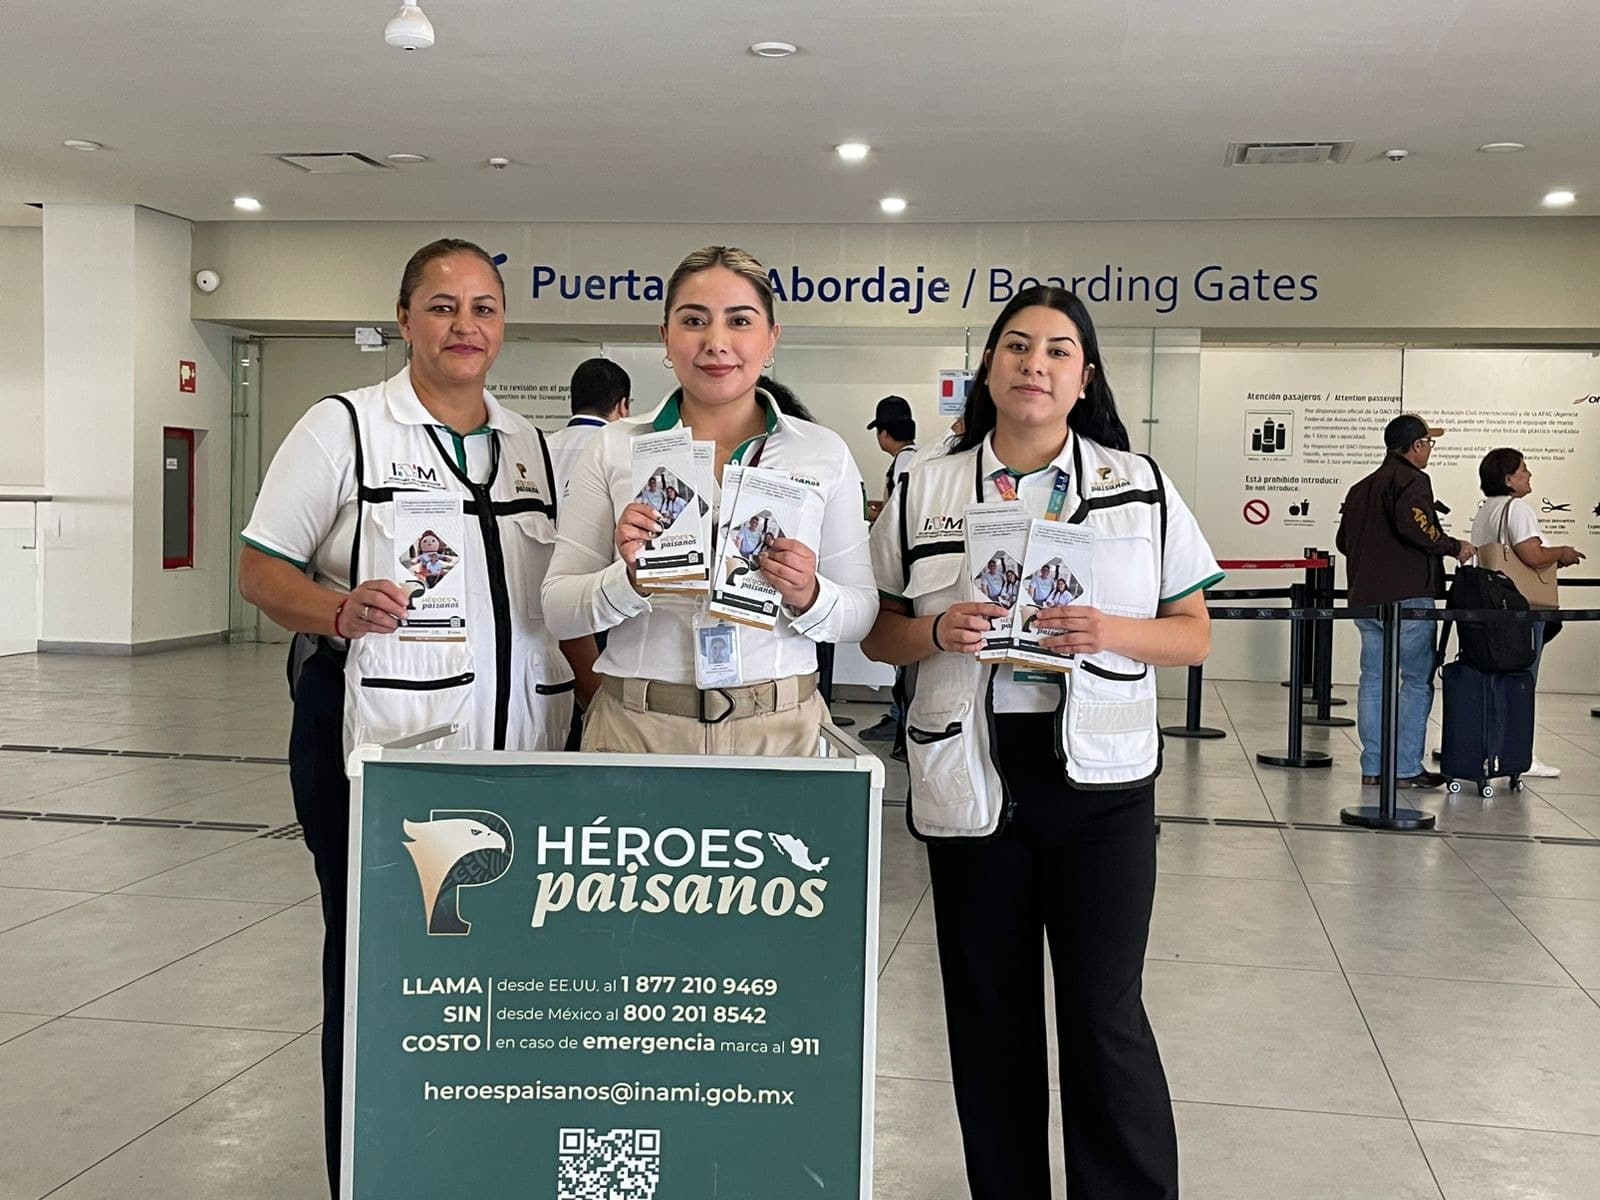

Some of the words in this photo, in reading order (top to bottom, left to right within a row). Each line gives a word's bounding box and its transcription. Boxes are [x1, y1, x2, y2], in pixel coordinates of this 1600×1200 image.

[532, 266, 664, 301] Puerta
[768, 265, 950, 314] Abordaje
[962, 268, 976, 309] /
[1194, 265, 1318, 301] Gates
[1248, 392, 1280, 400] Atención
[1282, 393, 1322, 402] pasajeros
[660, 539, 696, 550] paisanos
[422, 602, 459, 611] paisanos
[537, 816, 764, 869] HÉROES
[531, 862, 828, 928] paisanos
[402, 977, 483, 995] LLAMA
[497, 979, 545, 992] desde
[549, 980, 600, 993] EE.UU.
[603, 980, 617, 993] al
[620, 976, 630, 993] 1
[635, 976, 676, 994] 877
[681, 976, 717, 994] 210
[722, 977, 778, 996] 9469
[443, 1006, 481, 1023] SIN
[496, 1008, 544, 1021] desde
[548, 1007, 602, 1021] México
[605, 1008, 619, 1021] al
[623, 1005, 666, 1022] 800
[671, 1005, 707, 1022] 201
[712, 1006, 767, 1025] 8542
[402, 1035, 481, 1053] COSTO
[495, 1038, 516, 1050] en
[519, 1039, 555, 1050] caso
[559, 1036, 579, 1050] de
[583, 1033, 715, 1054] emergencia
[720, 1041, 768, 1054] marca
[772, 1040, 785, 1055] al
[790, 1038, 820, 1056] 911
[424, 1080, 794, 1107] heroespaisanos@inami.gob.mx
